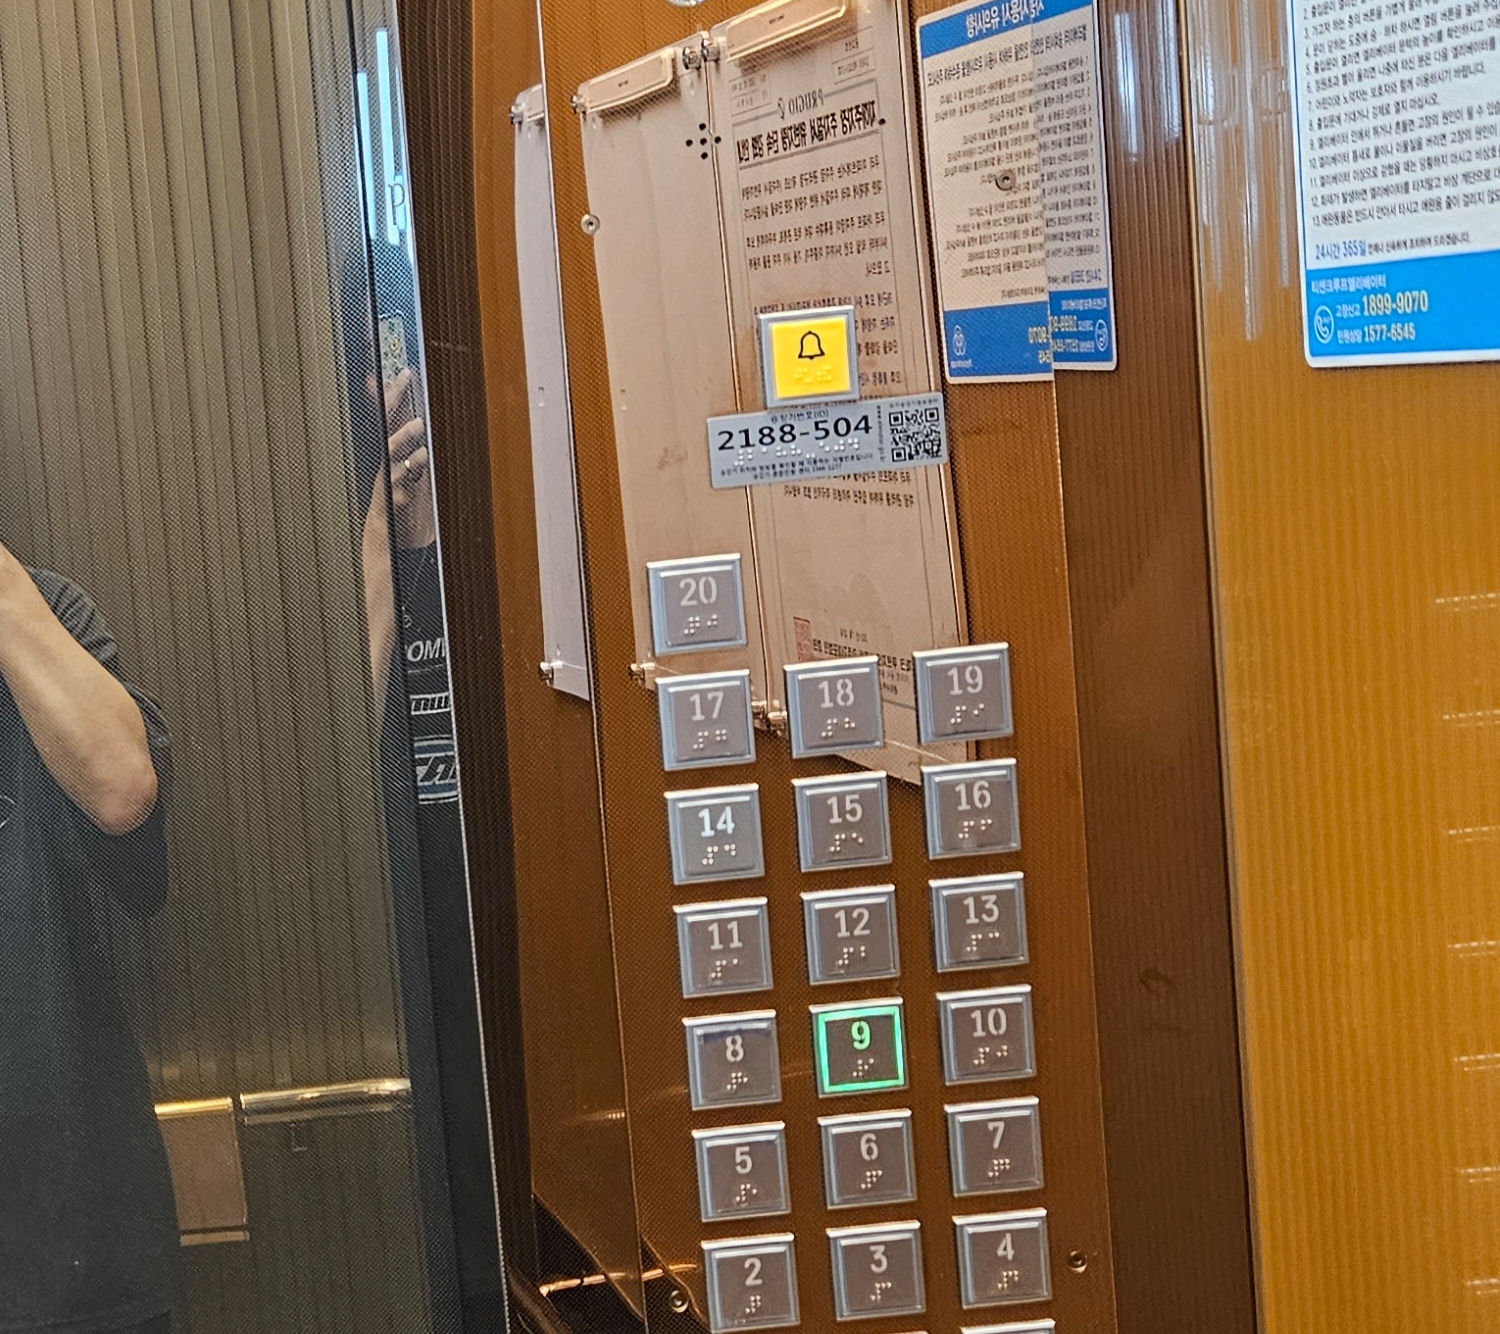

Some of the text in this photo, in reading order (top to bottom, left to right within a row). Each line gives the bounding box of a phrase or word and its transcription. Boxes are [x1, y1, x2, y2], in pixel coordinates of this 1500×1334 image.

[1315, 239, 1366, 260] 24시간 365일
[1363, 290, 1428, 315] 1899-9070
[1364, 322, 1415, 341] 1577-6545
[717, 415, 873, 450] 2188-504
[679, 576, 717, 605] 20
[819, 678, 855, 708] 18
[947, 666, 983, 695] 19
[689, 692, 724, 721] 17
[827, 794, 862, 824] 15
[955, 781, 991, 810] 16
[699, 806, 734, 837] 14
[835, 908, 870, 937] 12
[963, 895, 999, 924] 13
[708, 921, 742, 949] 11
[851, 1021, 871, 1050] 9
[971, 1008, 1007, 1037] 10
[726, 1034, 744, 1062] 8
[860, 1133, 879, 1160] 6
[988, 1121, 1005, 1149] 7
[735, 1146, 752, 1174] 5
[870, 1245, 888, 1273] 3
[997, 1233, 1015, 1260] 4
[744, 1257, 762, 1286] 2
